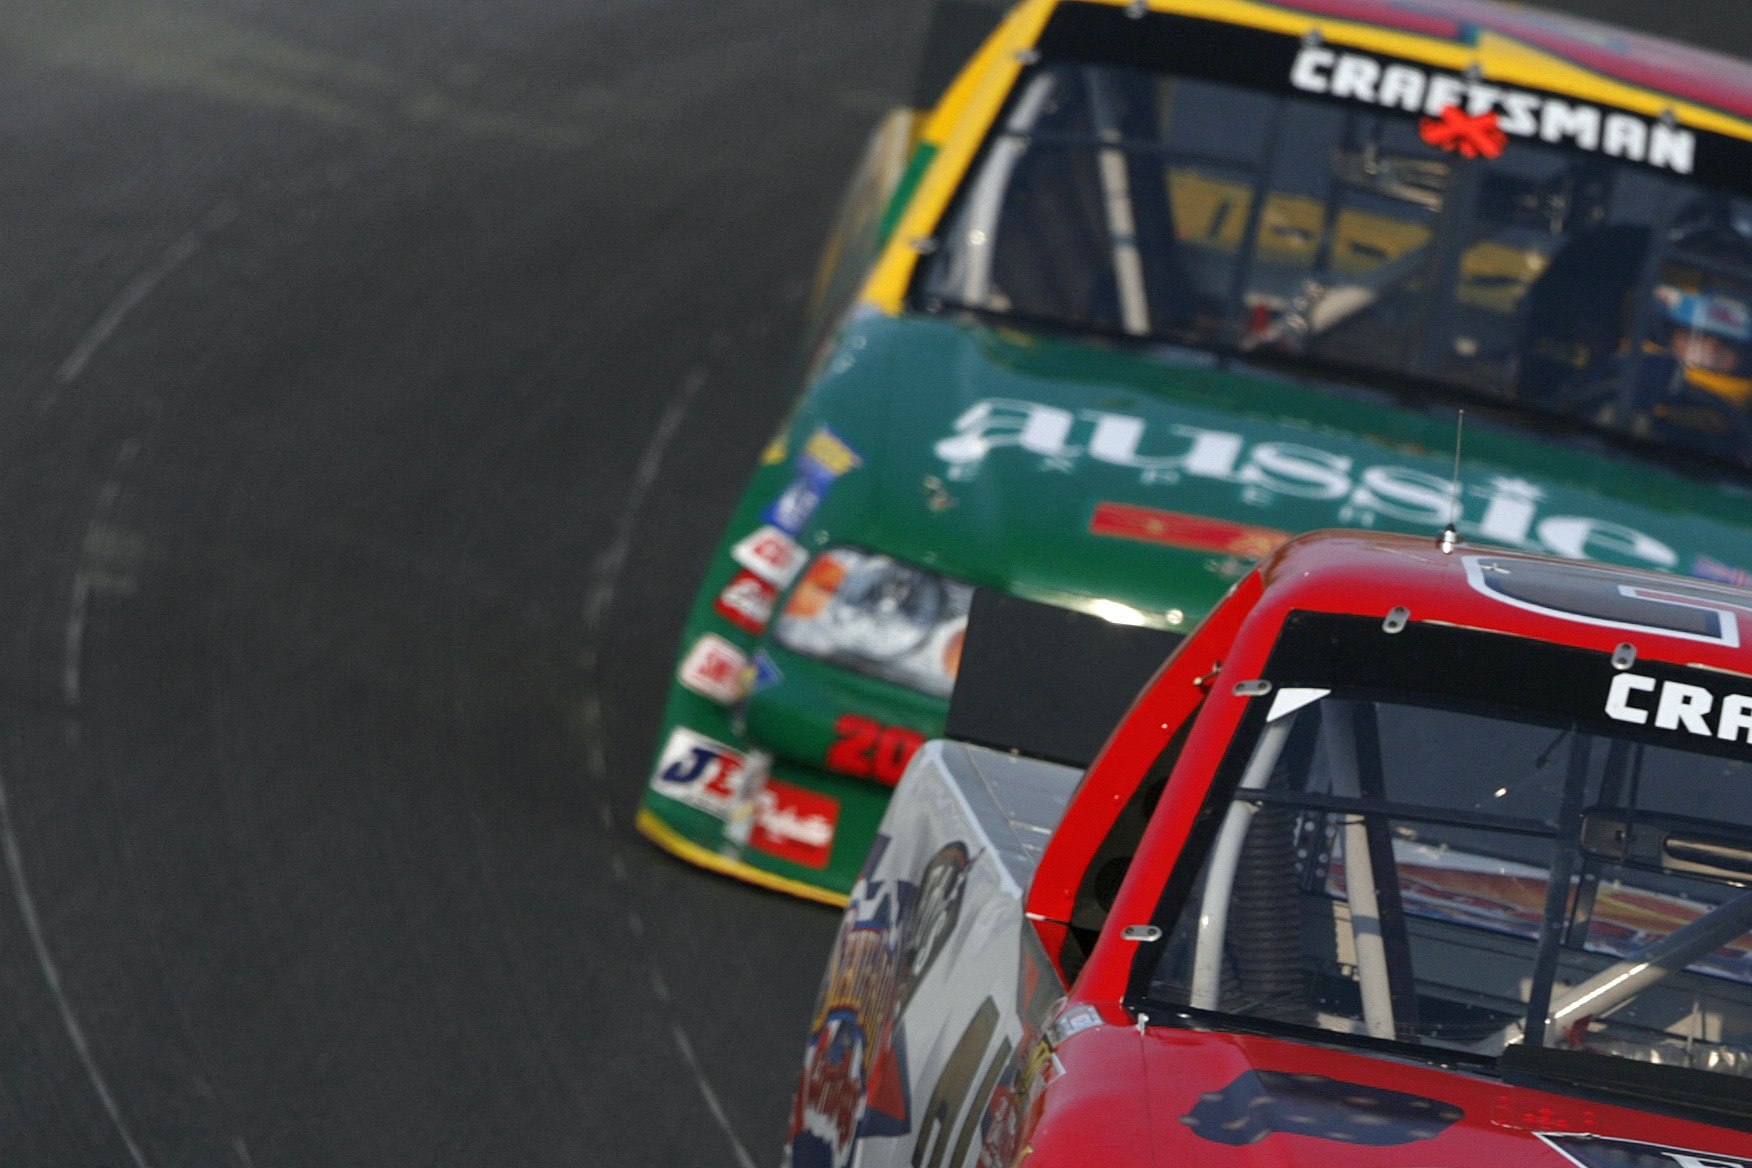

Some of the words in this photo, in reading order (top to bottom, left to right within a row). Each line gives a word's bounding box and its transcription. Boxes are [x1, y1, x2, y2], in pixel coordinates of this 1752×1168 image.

[1290, 45, 1697, 175] CRAFTSMAN
[933, 397, 1680, 567] aussie
[826, 712, 927, 788] 20
